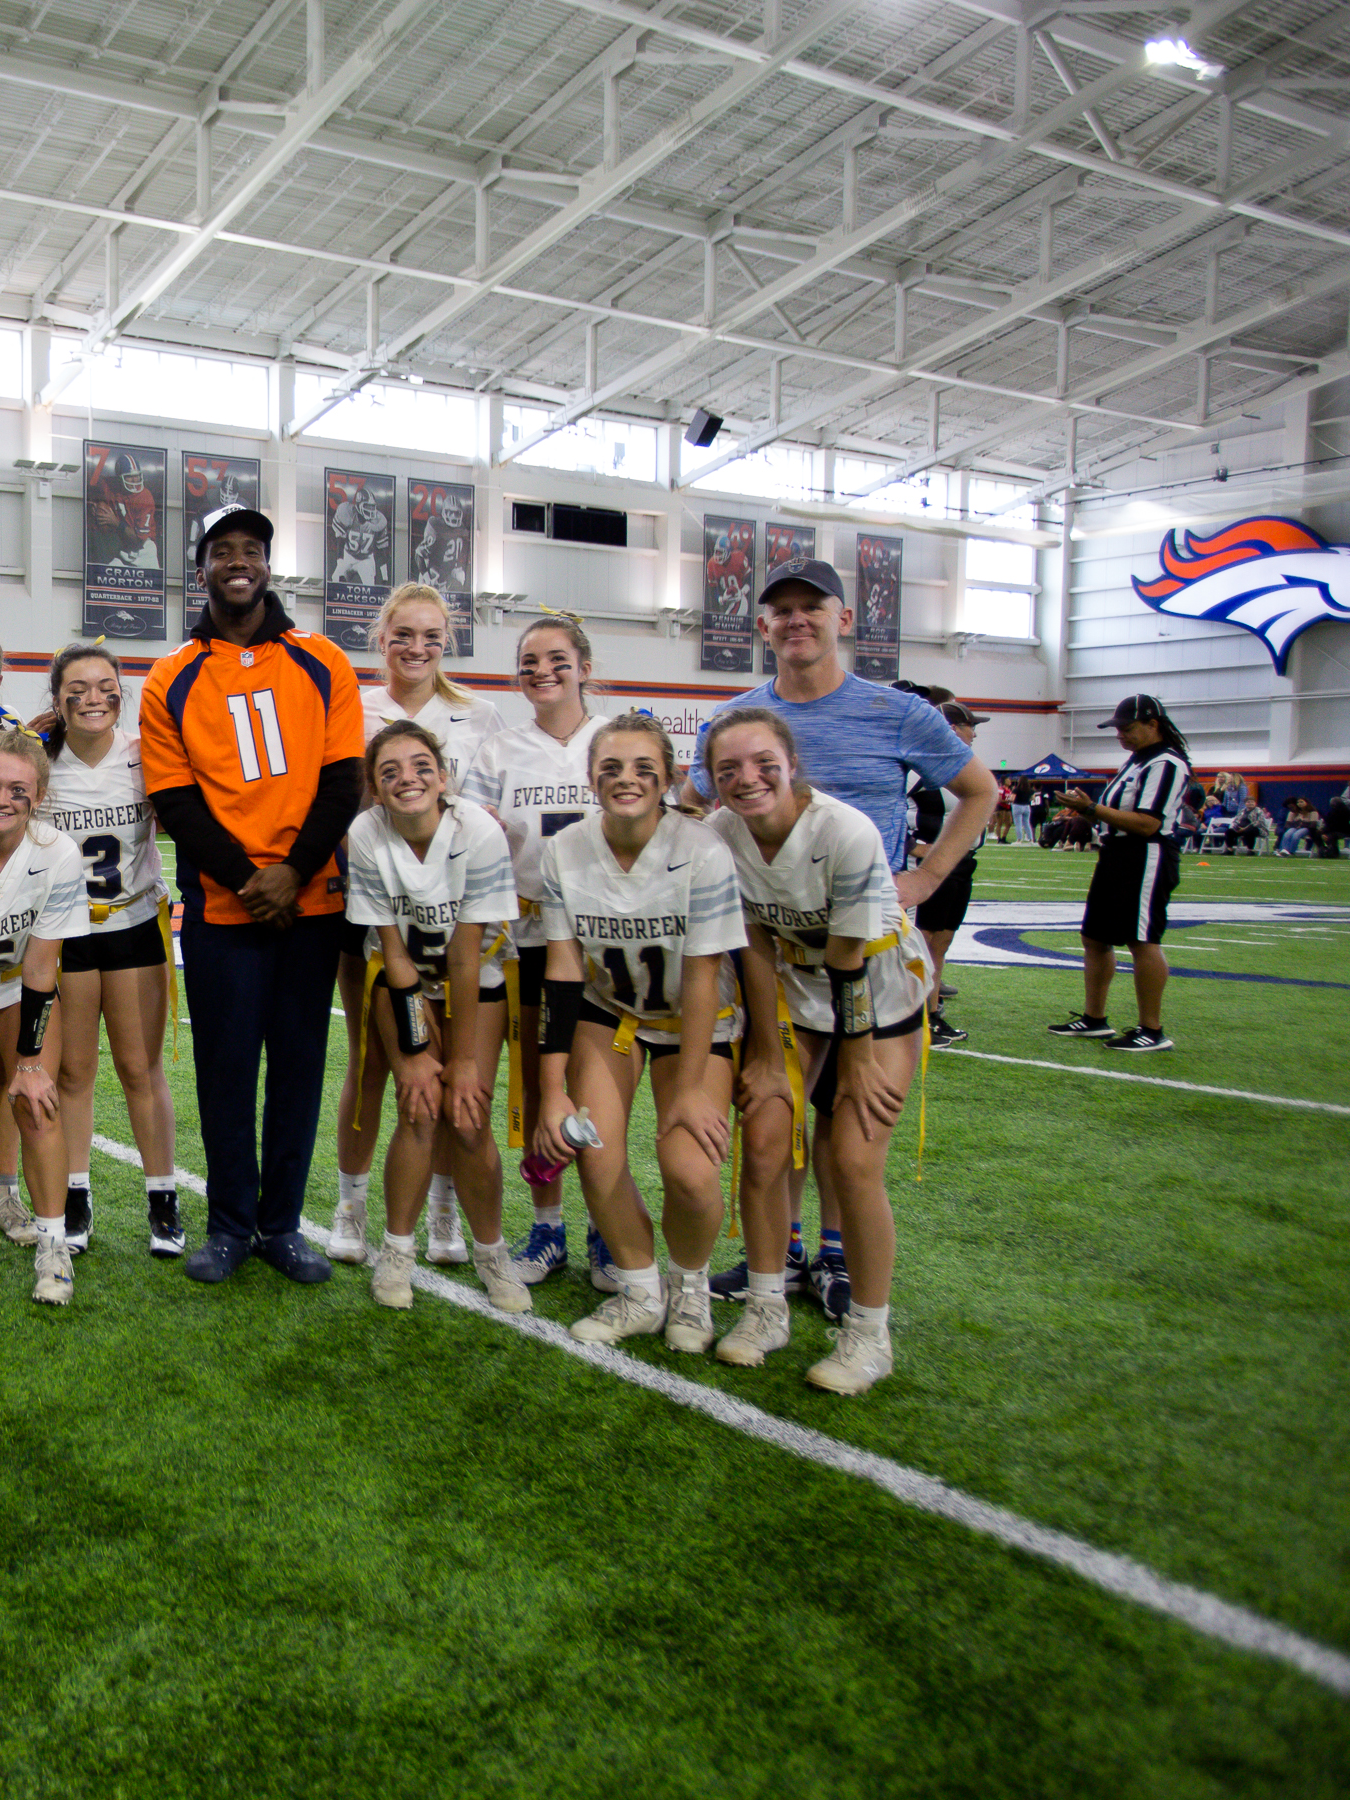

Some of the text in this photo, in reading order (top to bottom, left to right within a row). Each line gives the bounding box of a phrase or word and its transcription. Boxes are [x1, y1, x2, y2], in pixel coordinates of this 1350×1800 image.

[89, 446, 111, 486] 7
[97, 576, 153, 588] MORTON
[105, 568, 145, 578] CRAIG
[90, 592, 133, 601] QUARTERBACK
[333, 593, 385, 604] JACKSON
[347, 586, 371, 594] TOM
[227, 688, 288, 783] 11
[513, 785, 600, 808] EVERGREE
[53, 802, 143, 831] EVERGREEN
[80, 833, 125, 901] 3
[574, 914, 687, 939] EVERGREEN
[407, 924, 448, 982] 5
[602, 945, 671, 1011] 11
